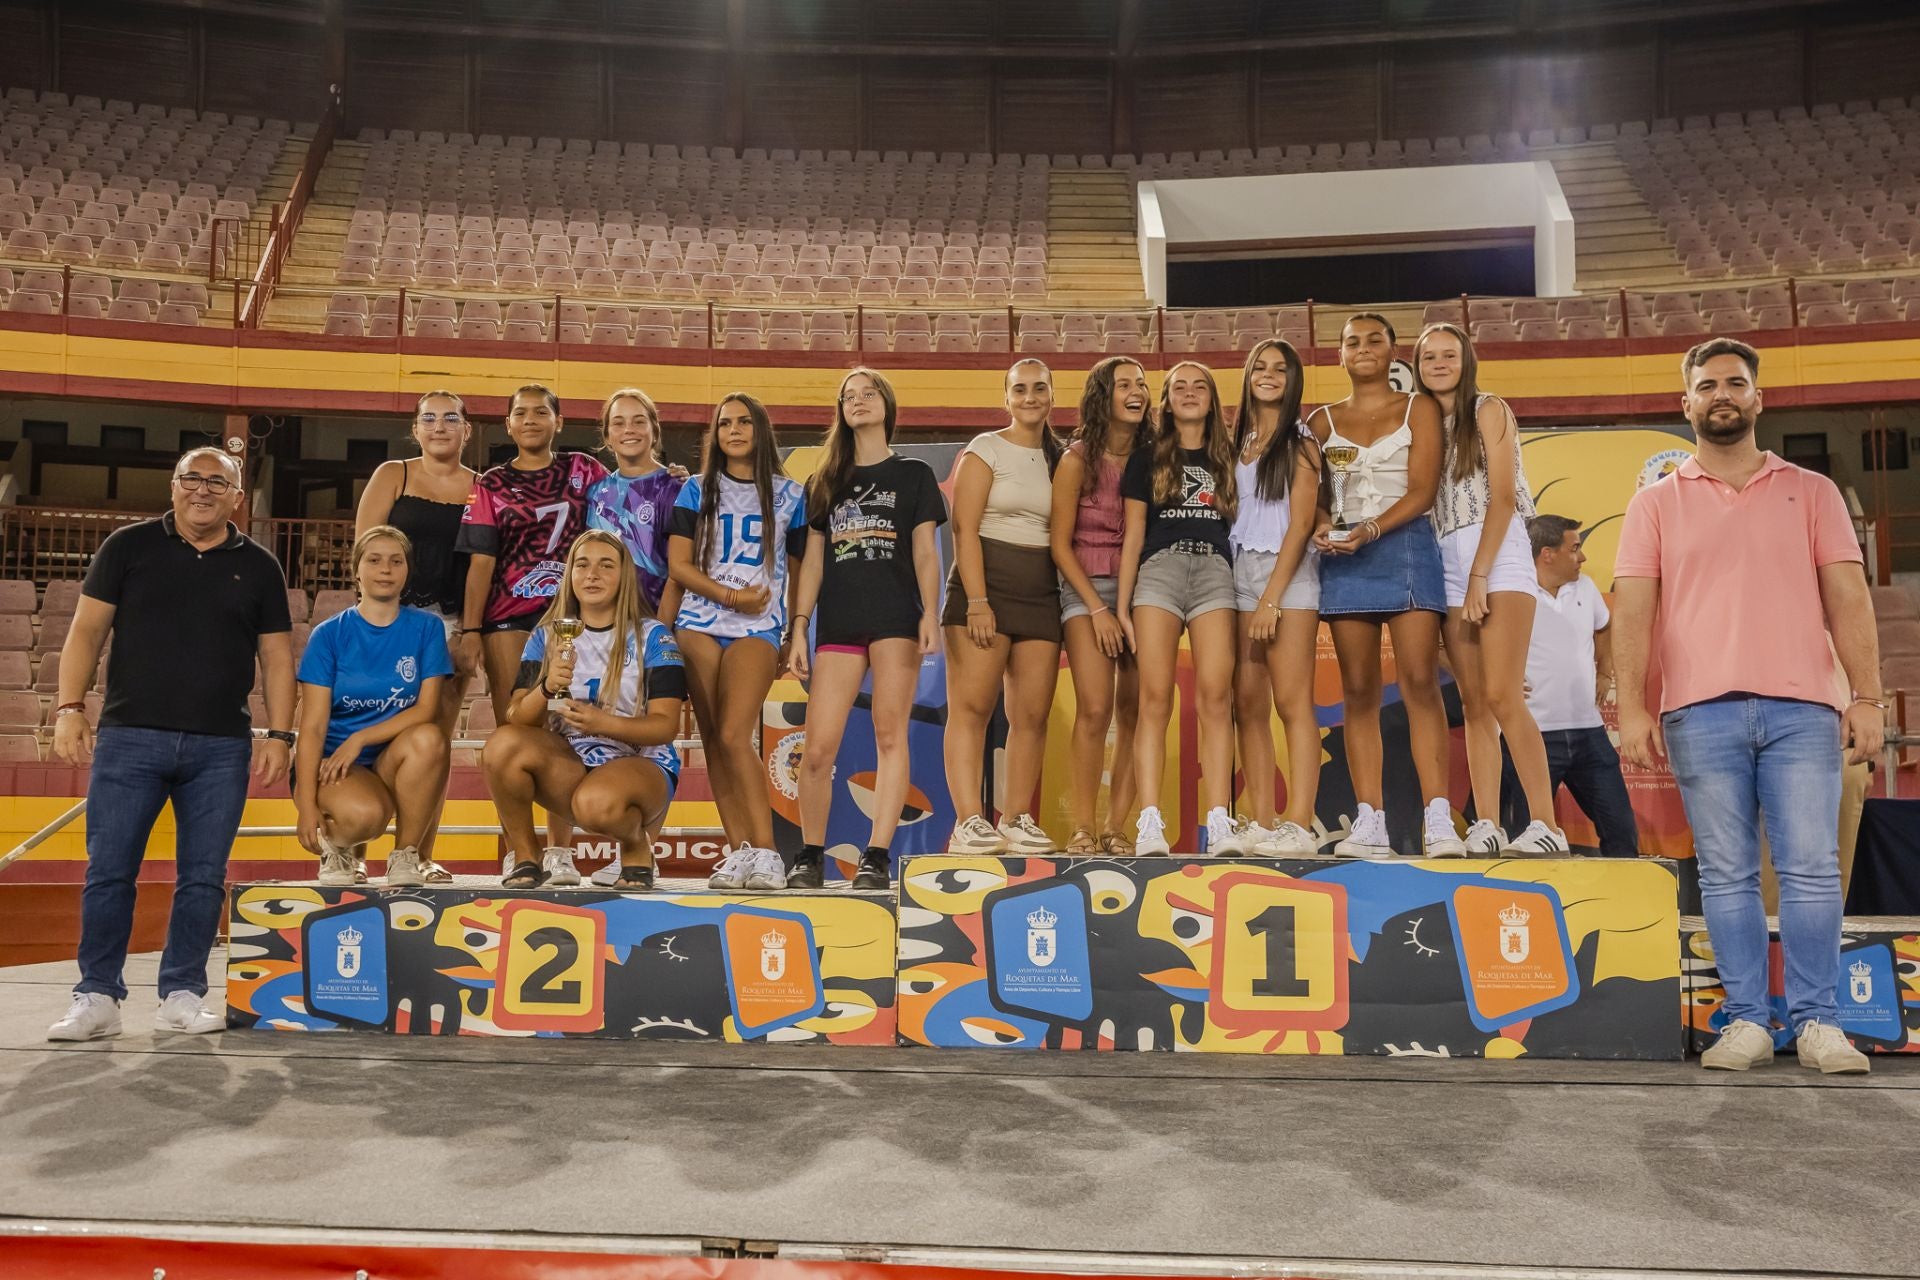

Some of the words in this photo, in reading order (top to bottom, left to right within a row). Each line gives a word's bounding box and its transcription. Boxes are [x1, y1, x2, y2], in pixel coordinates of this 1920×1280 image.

[535, 501, 570, 555] 7
[830, 519, 895, 534] VOLEIBOL
[1621, 763, 1639, 774] DE
[1634, 782, 1659, 791] Tiempo
[1660, 782, 1677, 790] Libre
[519, 926, 586, 1006] 2
[1245, 905, 1310, 997] 1
